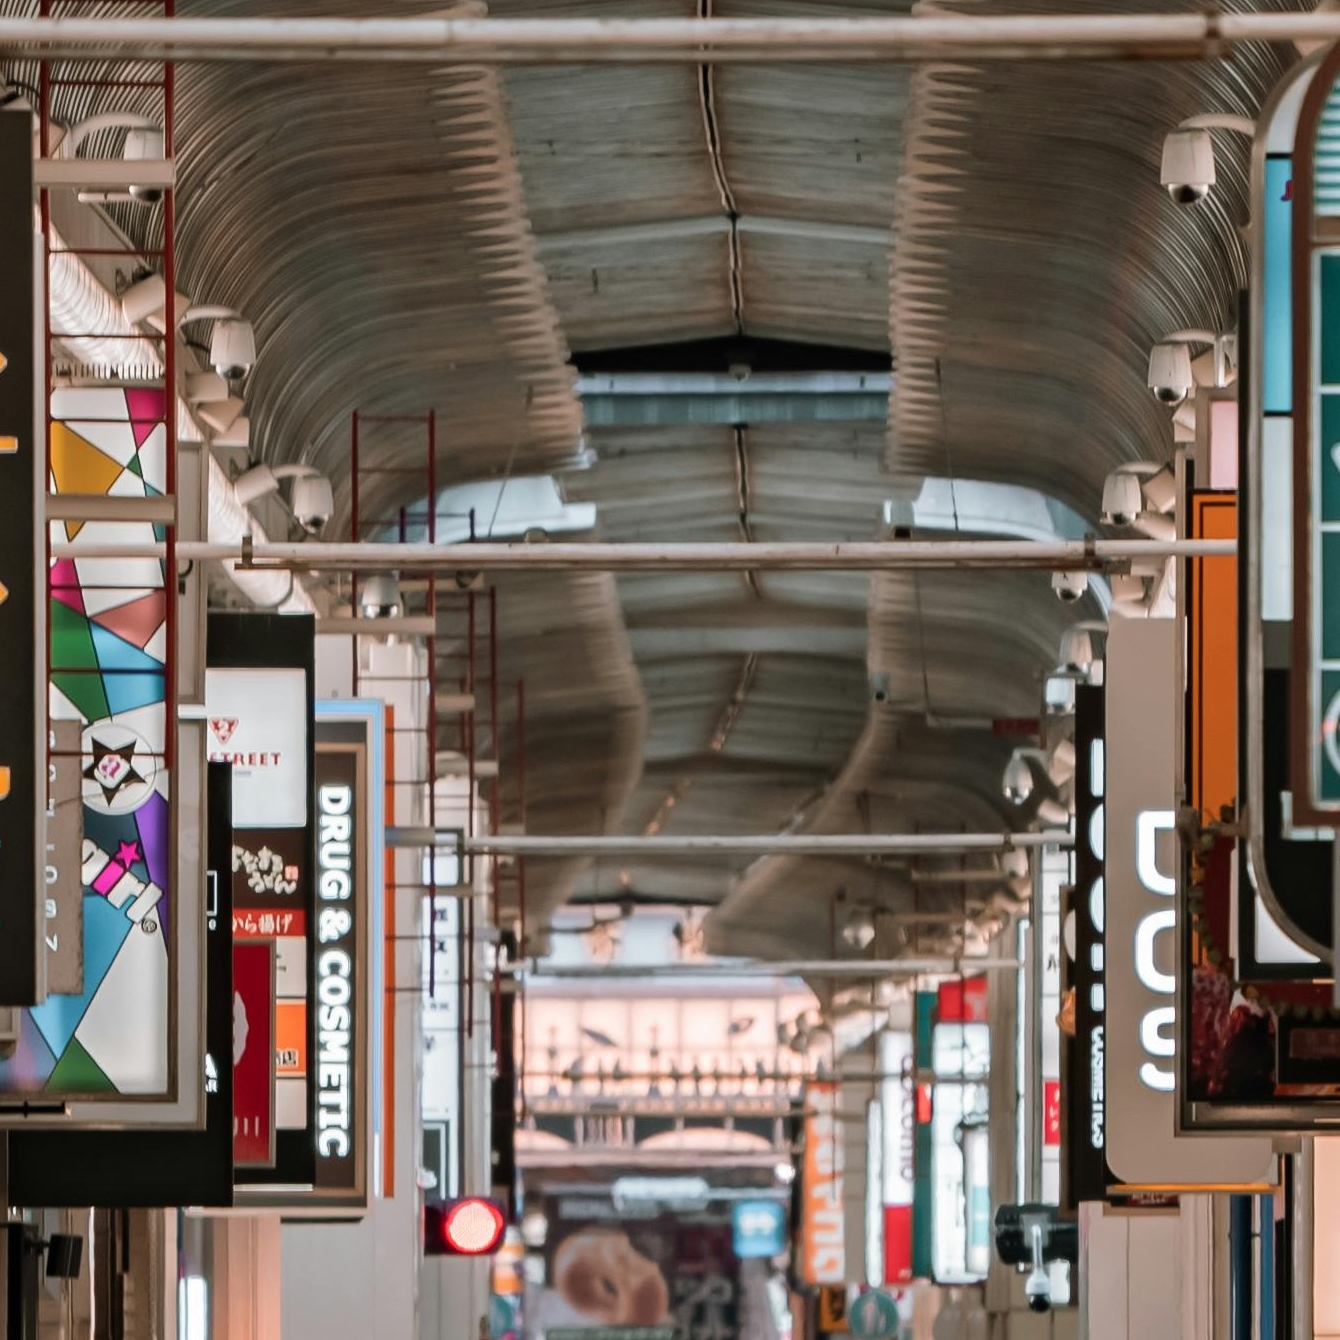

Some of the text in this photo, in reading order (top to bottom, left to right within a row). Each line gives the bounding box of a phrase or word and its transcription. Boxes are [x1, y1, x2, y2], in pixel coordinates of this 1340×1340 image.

[318, 785, 352, 1158] DRUG & COSMETIC
